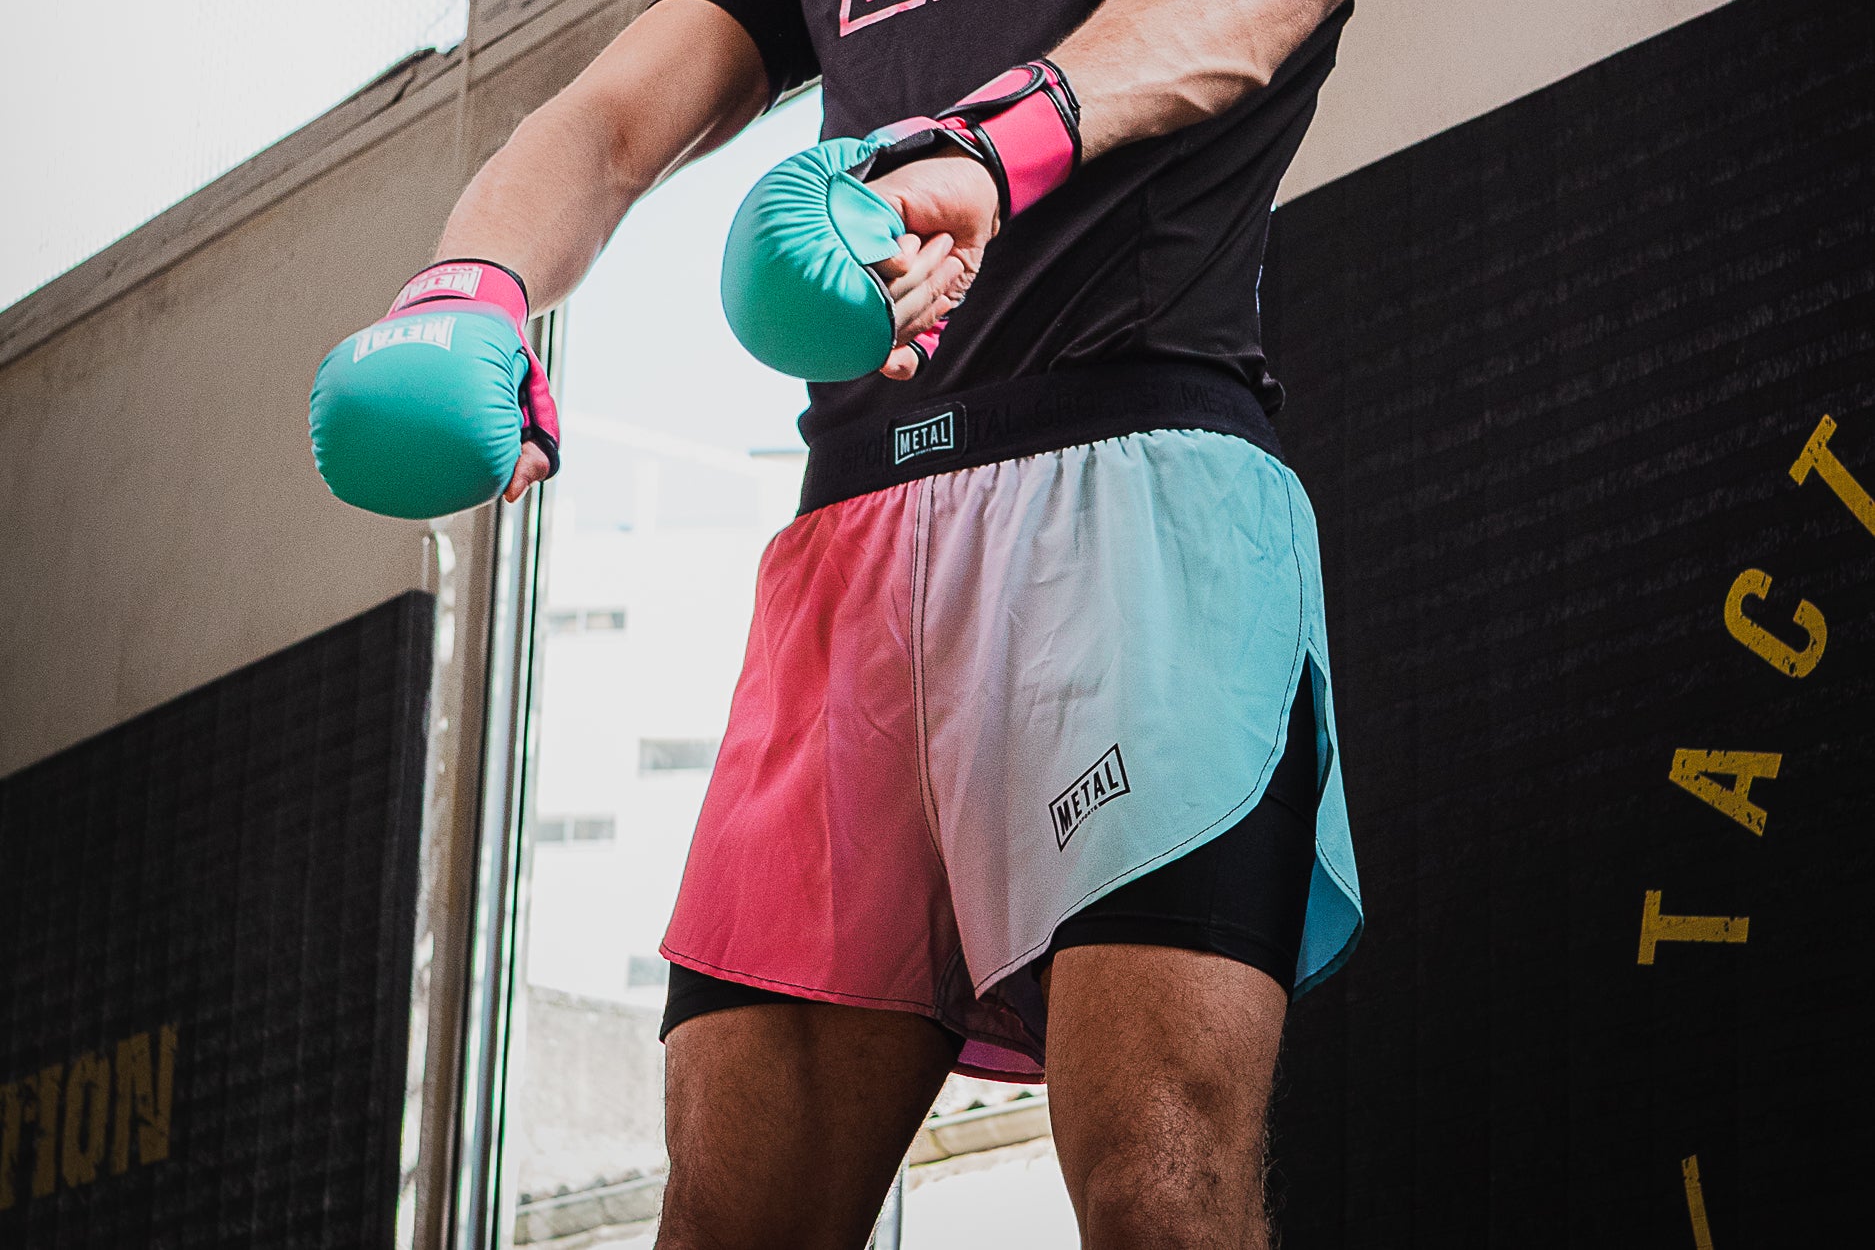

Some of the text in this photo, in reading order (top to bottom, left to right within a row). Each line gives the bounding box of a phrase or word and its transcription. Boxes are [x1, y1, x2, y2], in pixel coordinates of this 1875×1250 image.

[356, 319, 451, 354] METAL
[900, 421, 948, 456] METAL
[1056, 761, 1119, 836] METAL
